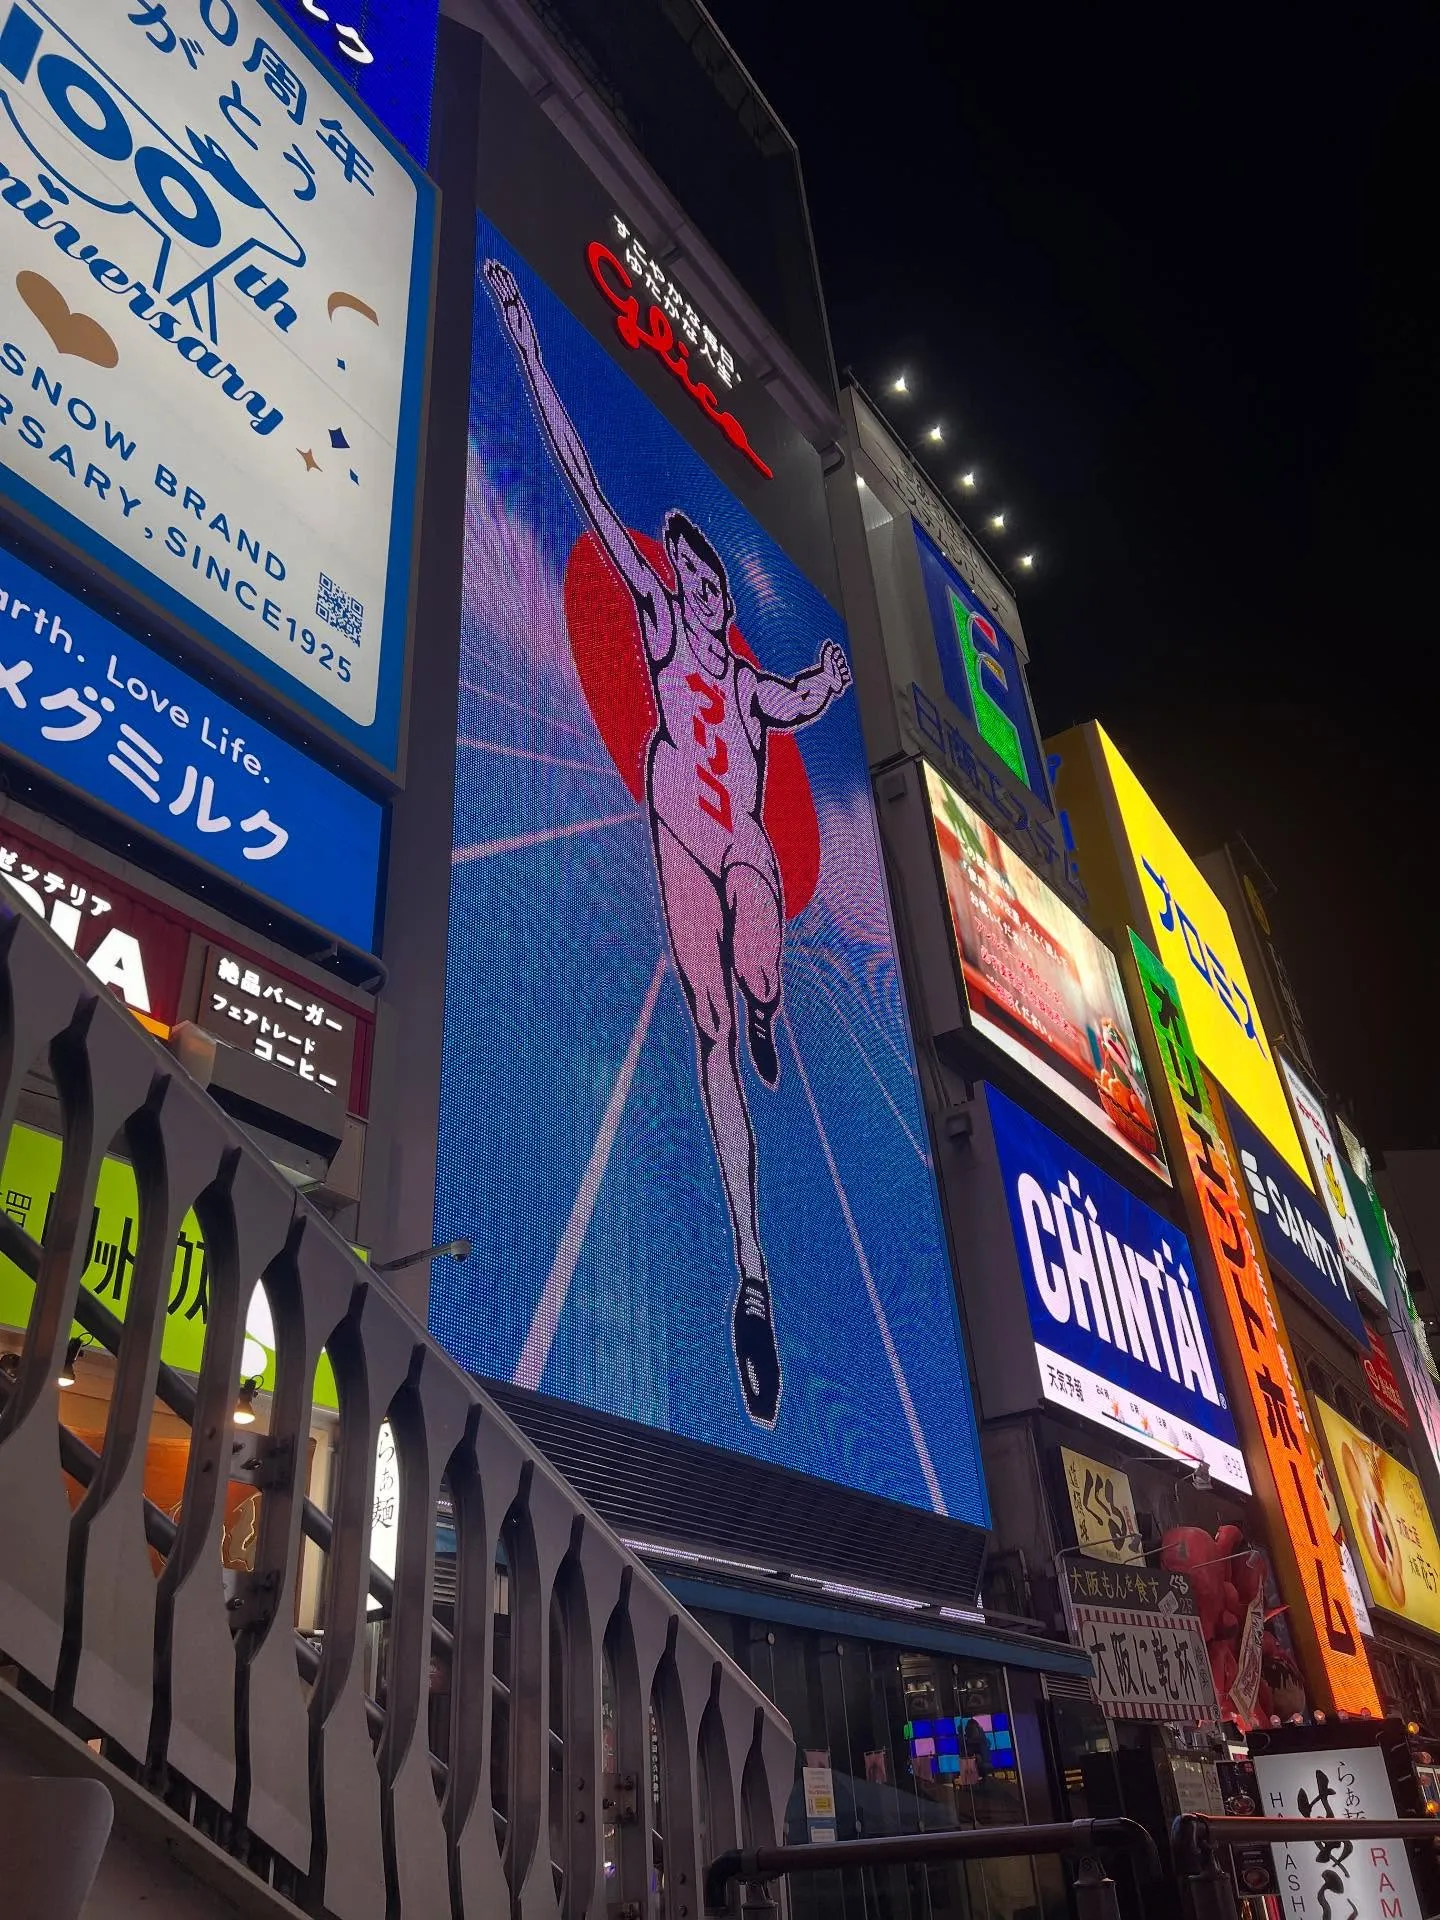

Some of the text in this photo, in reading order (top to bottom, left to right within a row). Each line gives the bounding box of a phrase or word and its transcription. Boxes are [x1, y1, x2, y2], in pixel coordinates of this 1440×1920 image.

[0, 342, 287, 582] SNOW BRAND
[106, 654, 190, 729] Love
[200, 715, 271, 785] Life.
[218, 957, 343, 1032] 絶品バーガー
[1141, 855, 1269, 1062] プロミス
[212, 993, 316, 1055] フェアトレード
[254, 1038, 338, 1087] コーヒー
[1017, 1169, 1221, 1406] CHINTAI
[1266, 1175, 1352, 1302] SAMTY
[1148, 977, 1357, 1657] オリエントホーム
[1045, 1363, 1085, 1403] 天気予報
[1069, 1566, 1159, 1604] 大阪もんを食す
[1088, 1624, 1198, 1703] 大阪に乾杯
